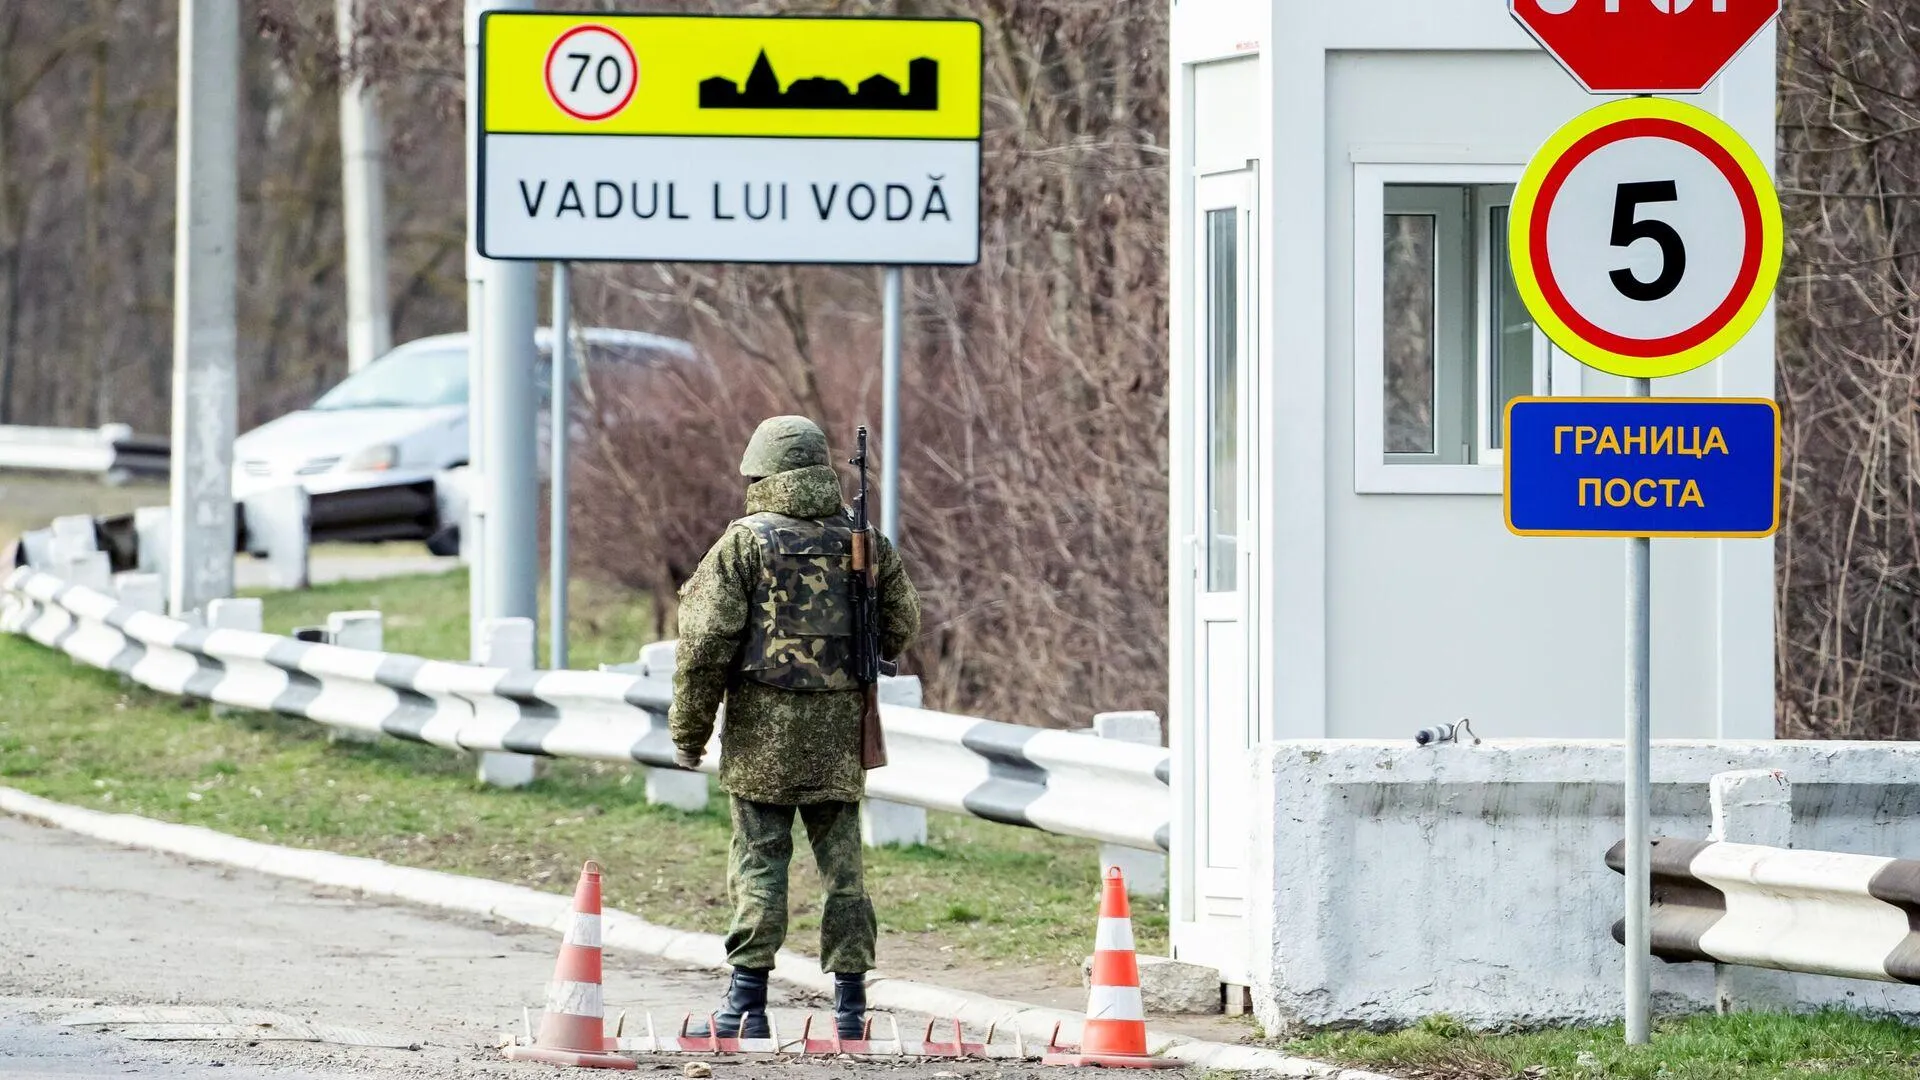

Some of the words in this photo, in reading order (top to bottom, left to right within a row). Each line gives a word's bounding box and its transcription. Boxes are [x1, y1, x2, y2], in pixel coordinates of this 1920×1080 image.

[567, 53, 622, 94] 70
[519, 180, 690, 220] VADUL
[713, 182, 788, 221] LUI
[811, 173, 952, 222] VODĂ
[1608, 179, 1687, 302] 5
[1553, 425, 1729, 459] ГРАНИЦА
[1578, 477, 1705, 508] ПОСТА
